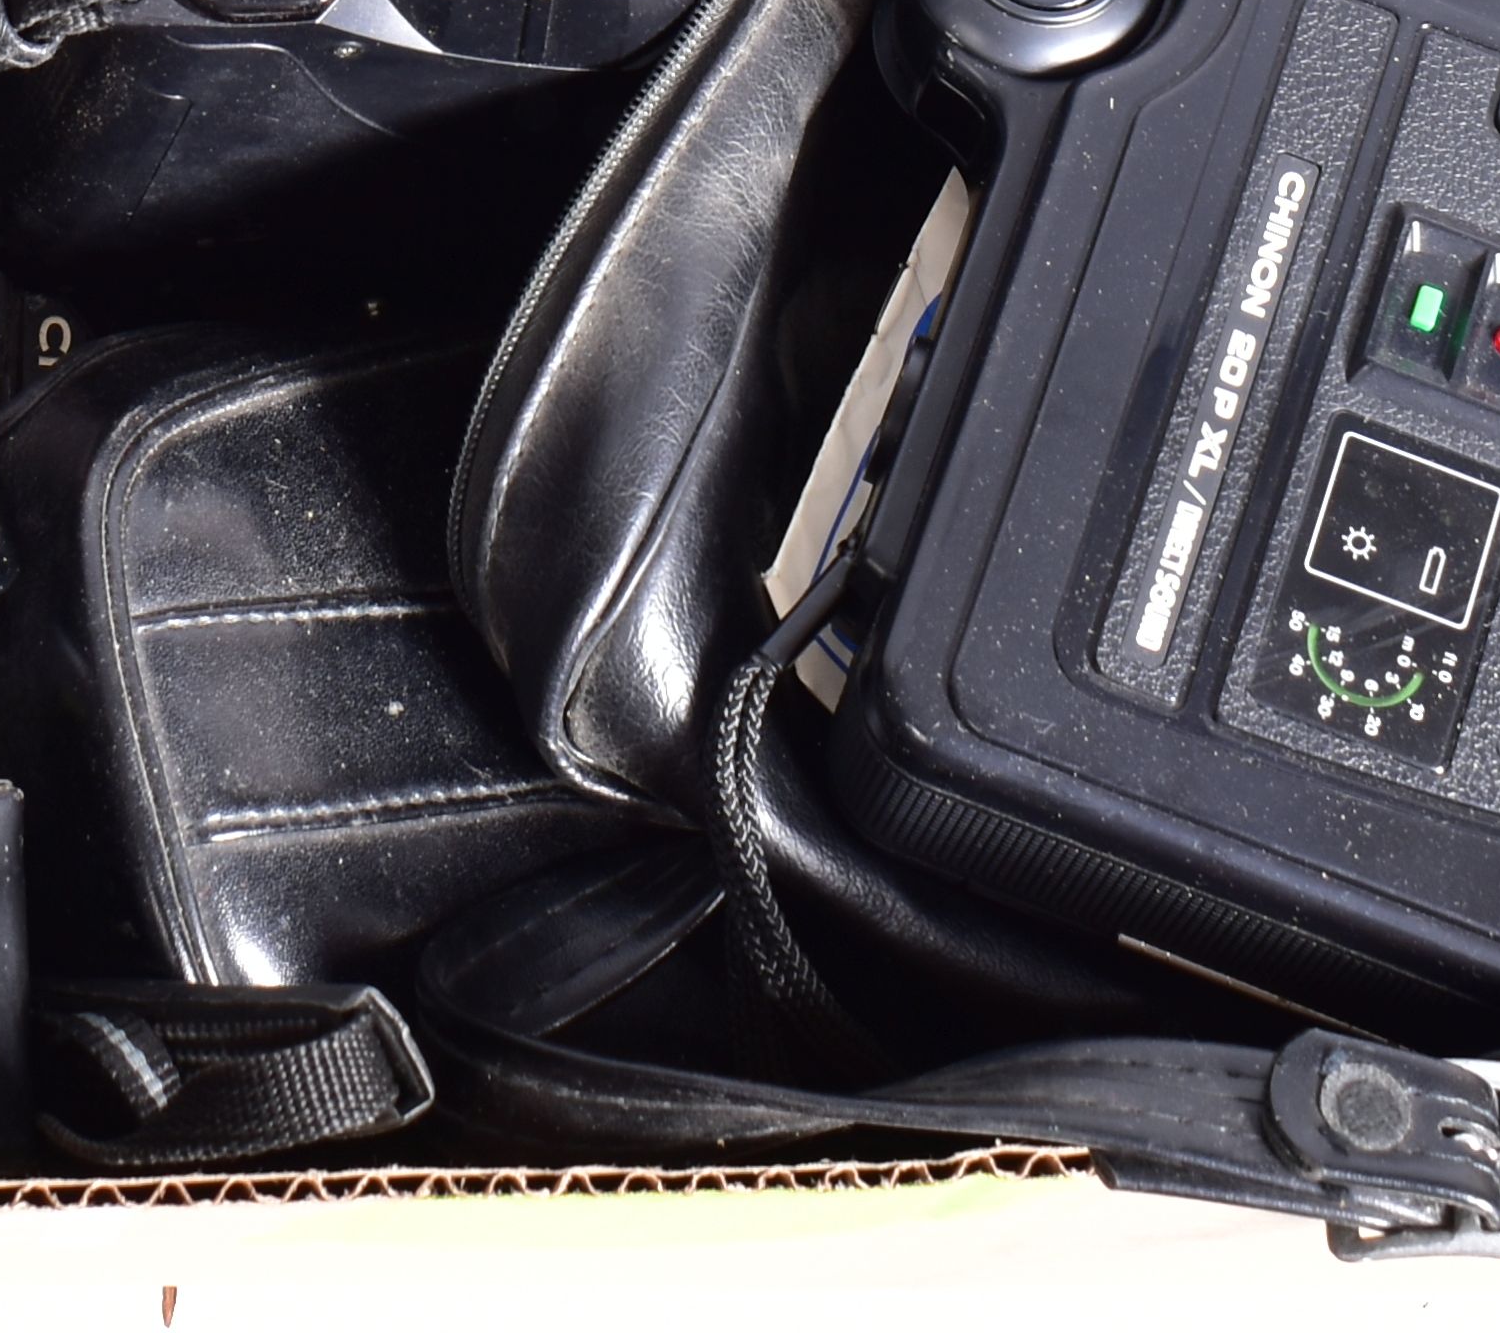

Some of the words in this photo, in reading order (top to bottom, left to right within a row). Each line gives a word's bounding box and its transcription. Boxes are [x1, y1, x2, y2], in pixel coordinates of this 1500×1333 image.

[1240, 170, 1306, 319] CHINON
[1288, 609, 1306, 632] 50
[1325, 625, 1342, 644] 15
[1288, 653, 1306, 677] 40
[1327, 649, 1345, 668] 12
[1396, 654, 1412, 668] 0
[1384, 670, 1400, 685] 3
[1437, 669, 1453, 684] 0
[1316, 694, 1335, 720] 30
[1409, 702, 1425, 721] 10
[1364, 713, 1382, 737] 20
